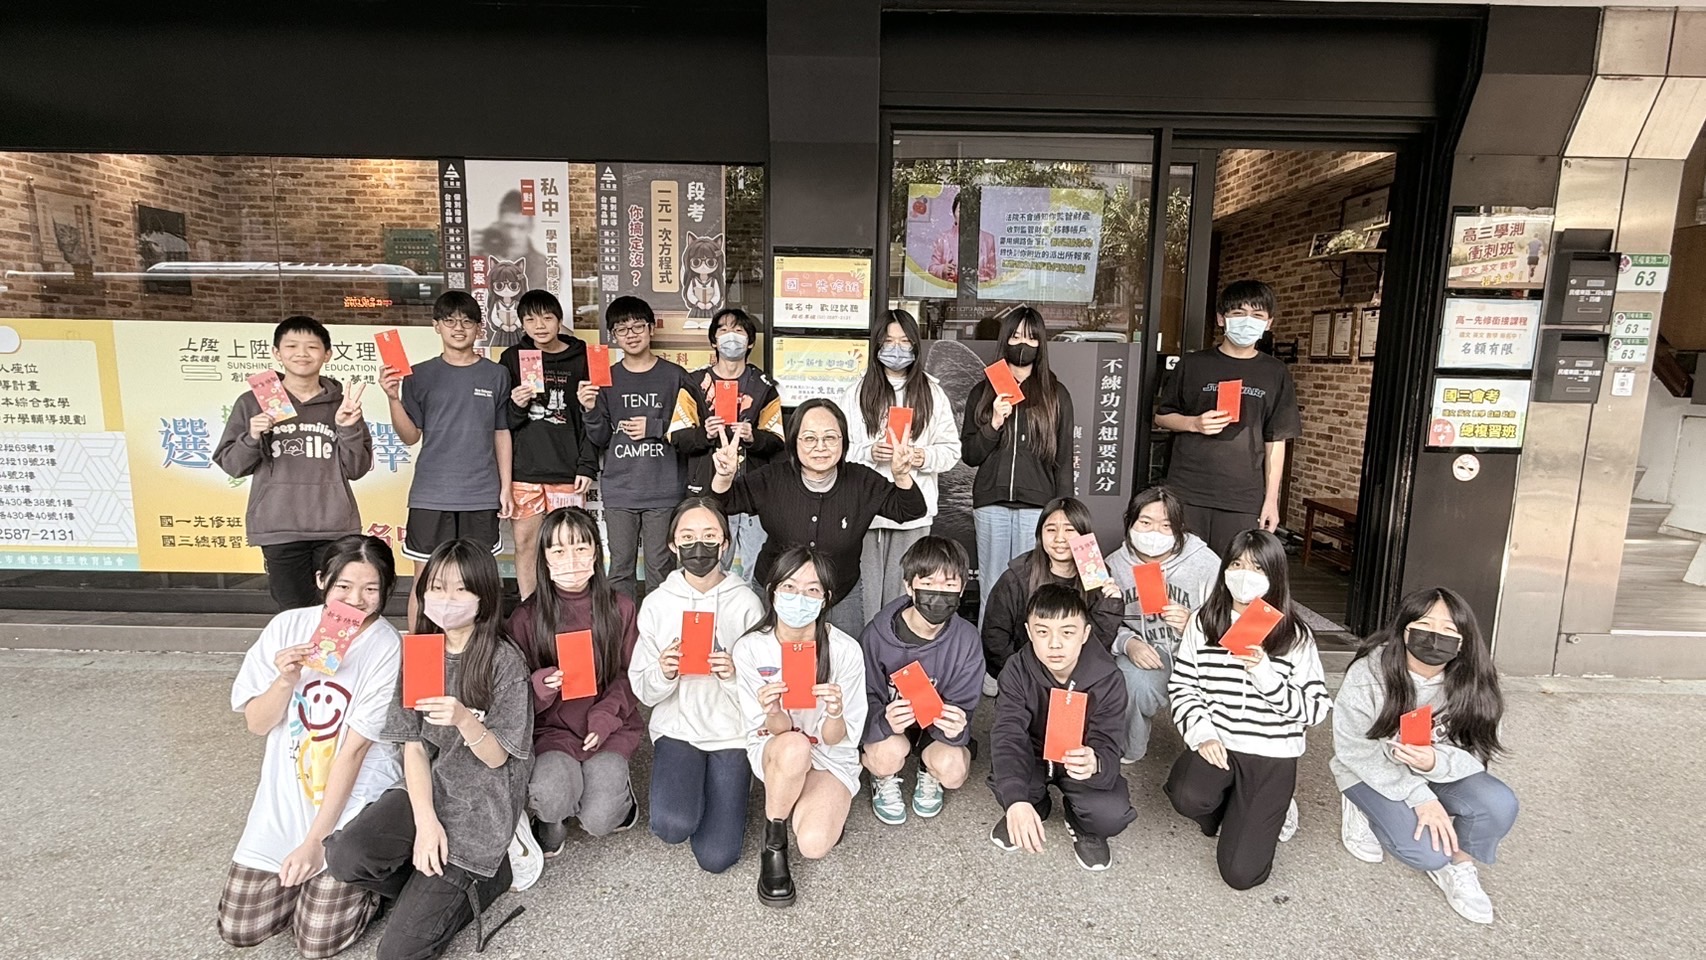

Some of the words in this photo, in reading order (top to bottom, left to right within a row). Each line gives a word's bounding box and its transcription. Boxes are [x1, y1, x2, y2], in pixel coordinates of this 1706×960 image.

[540, 177, 559, 217] 私中
[687, 181, 706, 223] 段考
[657, 188, 673, 285] 一元一次方程式
[1462, 219, 1526, 243] 高三學測
[1467, 241, 1515, 261] 衝刺班
[472, 259, 486, 285] 答案
[1634, 270, 1657, 287] 63
[785, 302, 813, 312] 報名中
[1455, 315, 1528, 327] 高一先修銜接課程
[1624, 323, 1640, 334] 63
[179, 337, 220, 352] 上陞
[227, 339, 271, 360] 上陞
[333, 341, 377, 362] 文理
[1461, 342, 1513, 355] 名額有限
[1620, 349, 1636, 360] 63
[227, 362, 274, 371] SUNSHINE
[324, 365, 378, 373] EDUCATION
[1202, 383, 1219, 392] ST
[1, 397, 71, 408] 本綜合教學
[621, 393, 659, 408] TENT
[1442, 387, 1500, 404] 國三會考
[271, 423, 297, 435] eep
[1094, 357, 1125, 493] 不練功又想要高分
[1459, 422, 1516, 439] 總複習班
[160, 416, 213, 469] 選
[614, 443, 665, 459] CAMPER
[159, 515, 243, 529] 國一先修班
[0, 528, 75, 541] 2587-2131
